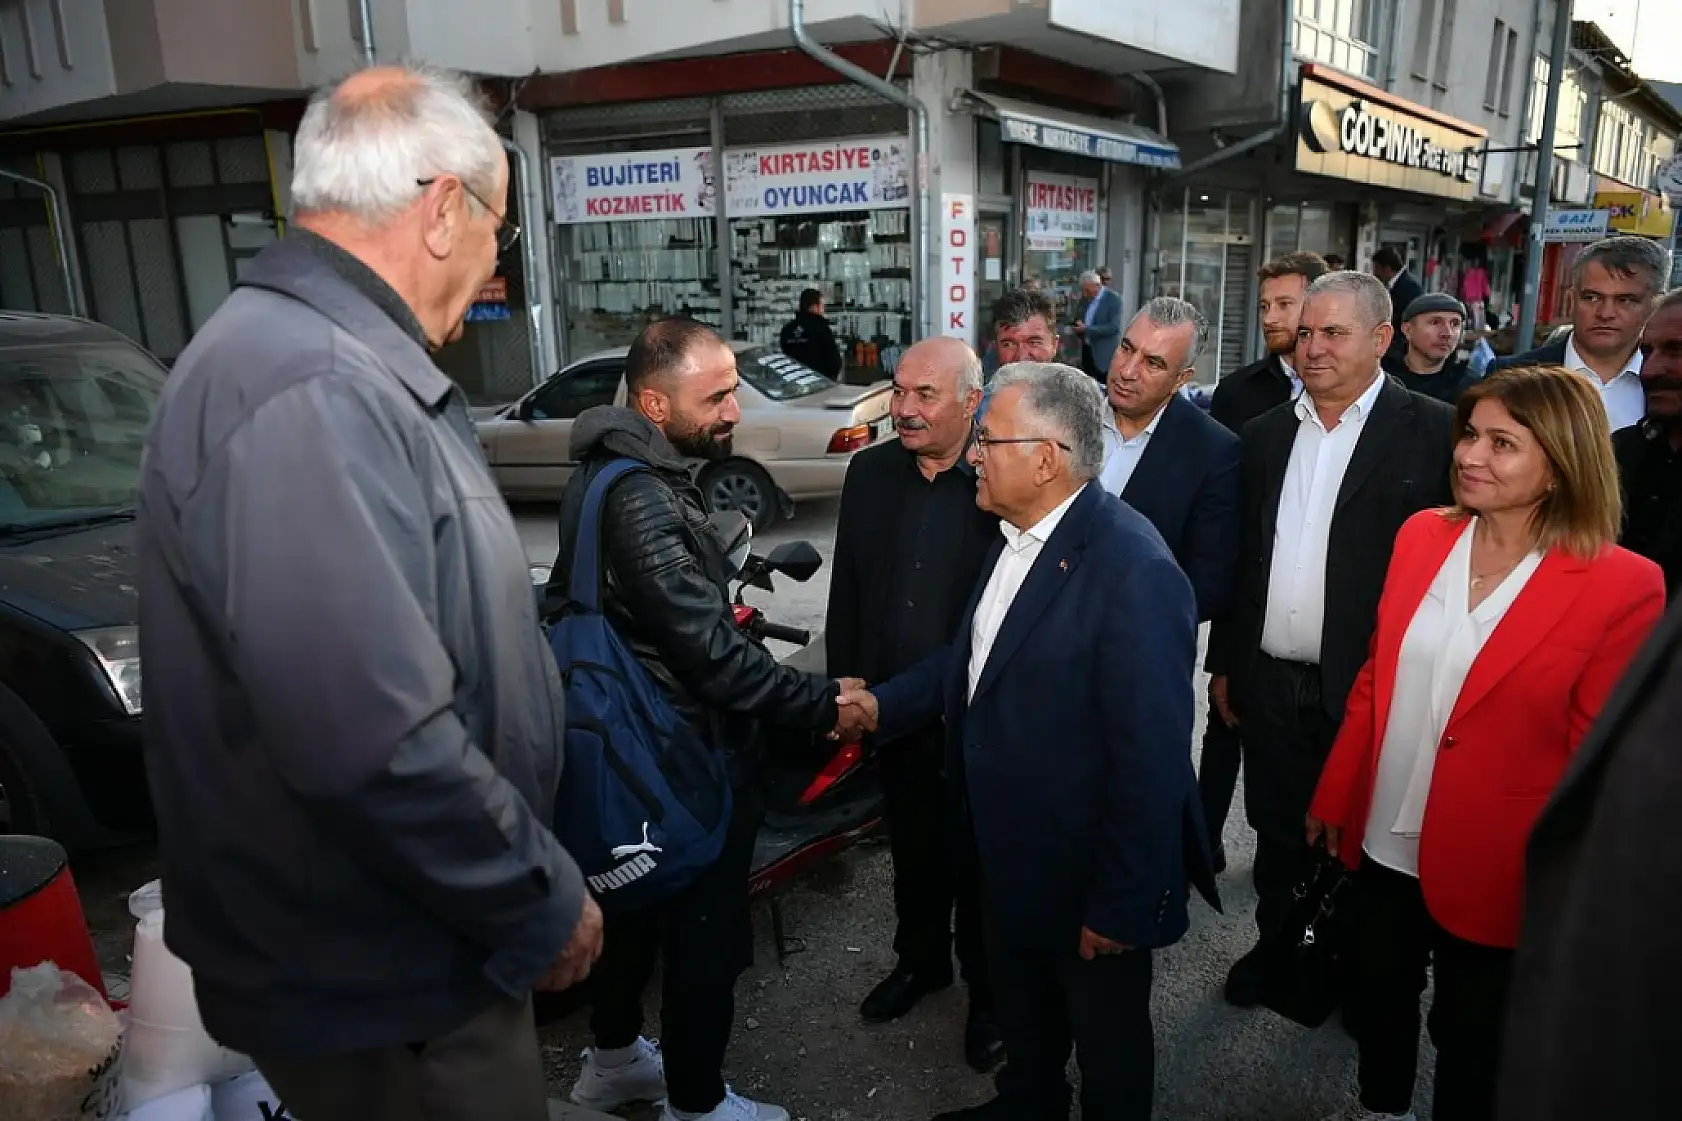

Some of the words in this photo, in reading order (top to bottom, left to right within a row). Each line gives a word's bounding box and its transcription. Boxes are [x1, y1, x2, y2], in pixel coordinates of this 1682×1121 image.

[586, 156, 681, 187] BUJİTERİ
[759, 144, 870, 177] KIRTASİYE
[586, 189, 686, 216] KOZMETİK
[764, 181, 868, 209] OYUNCAK
[950, 201, 966, 343] FOTOK
[587, 853, 657, 893] PUMA
